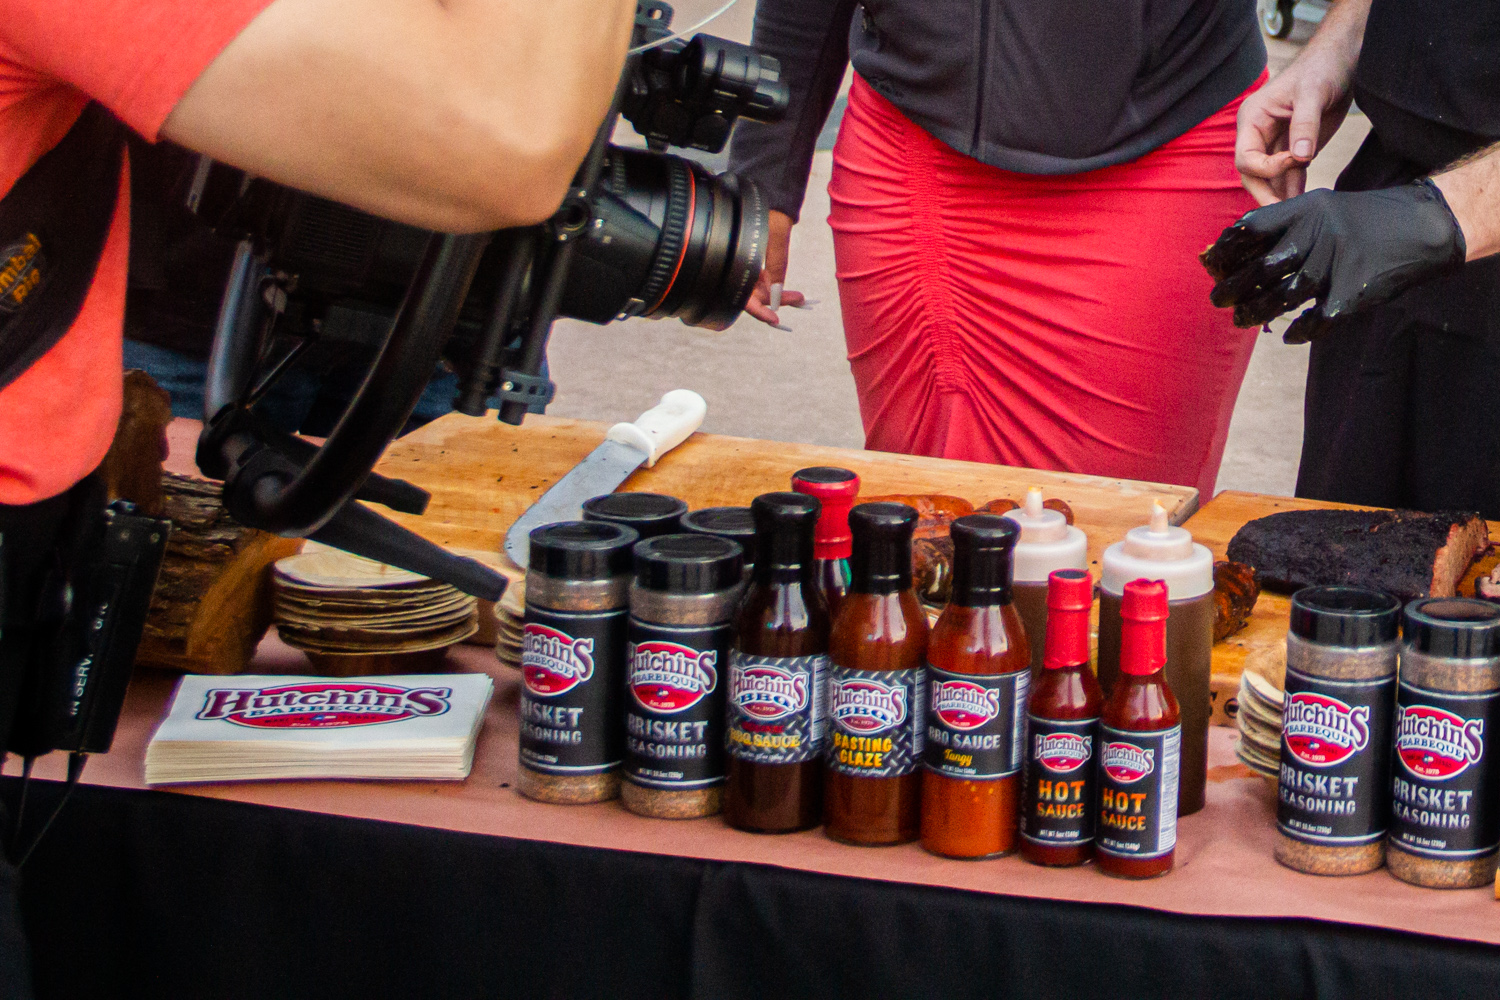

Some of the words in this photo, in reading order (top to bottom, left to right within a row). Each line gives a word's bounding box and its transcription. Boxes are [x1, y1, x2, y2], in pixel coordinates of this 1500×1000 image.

[0, 232, 41, 294] mbal
[635, 672, 699, 691] BARBEQUE
[250, 704, 401, 716] BARBEQUE
[627, 712, 709, 741] BRISKET
[1288, 724, 1350, 743] BARBEQUE
[753, 733, 801, 749] SAUCE
[834, 732, 893, 753] BASTING
[929, 725, 949, 744] BBQ
[953, 733, 1001, 750] SAUCE
[1402, 738, 1463, 758] BARBEQUE
[840, 749, 883, 767] GLAZE
[944, 749, 973, 767] Tangy
[1038, 779, 1086, 802] HOT
[1281, 762, 1359, 798] BRISKET
[1103, 787, 1147, 814] HOT
[1280, 786, 1356, 815] SEASONING
[1393, 776, 1473, 812] BRISKET
[1037, 802, 1085, 819] SAUCE
[1101, 810, 1147, 831] SAUCE
[1393, 799, 1471, 829] SEASONING
